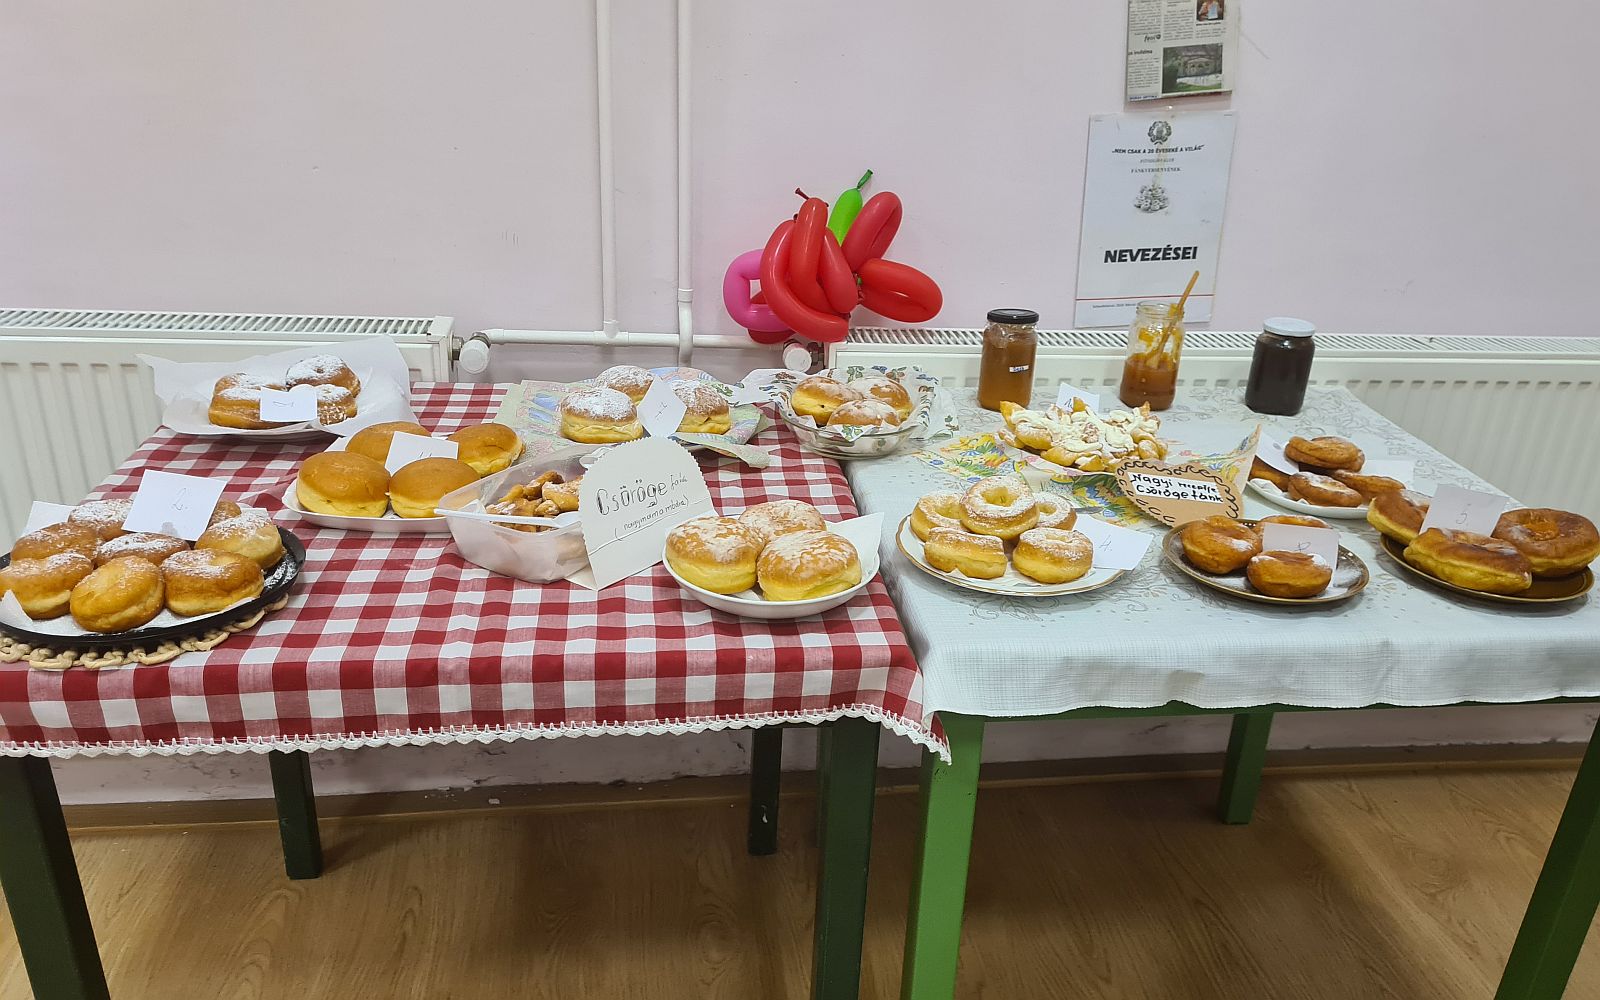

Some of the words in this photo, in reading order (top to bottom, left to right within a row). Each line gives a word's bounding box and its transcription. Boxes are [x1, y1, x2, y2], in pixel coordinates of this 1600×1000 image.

[1103, 244, 1198, 263] NEVEZÉSEI
[1130, 474, 1174, 488] Nagyi
[596, 479, 668, 516] Csöröge
